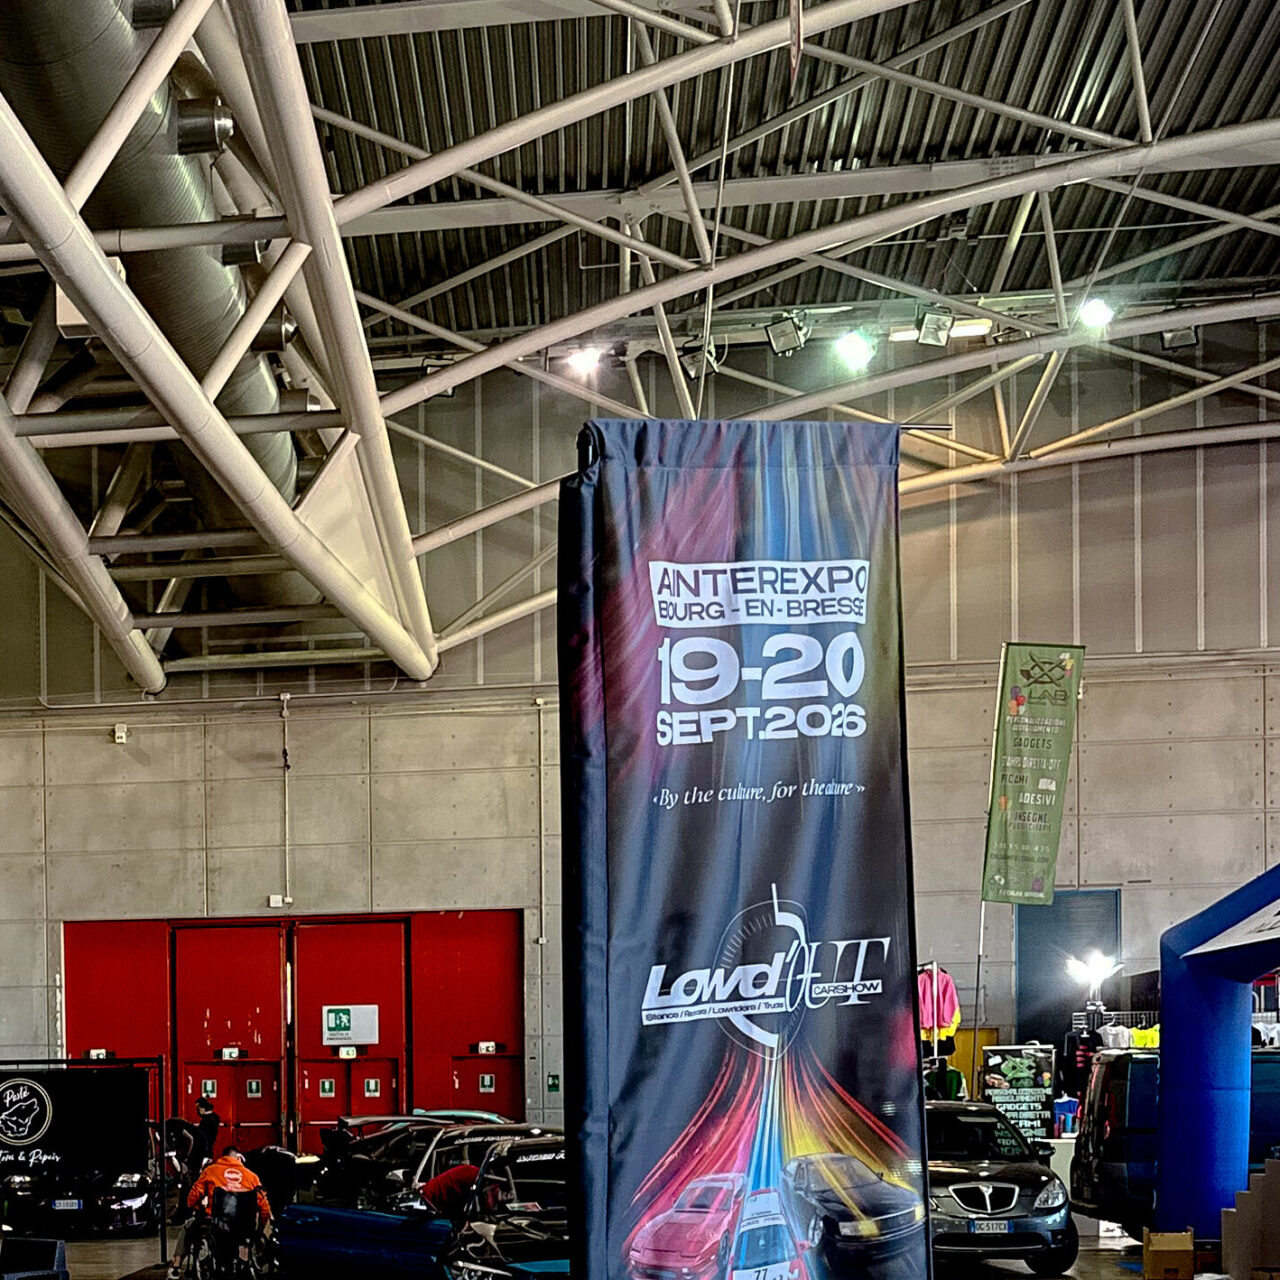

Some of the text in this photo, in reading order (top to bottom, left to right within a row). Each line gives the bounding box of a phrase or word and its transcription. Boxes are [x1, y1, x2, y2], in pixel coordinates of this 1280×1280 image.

[657, 566, 867, 596] AINTEREXPO
[658, 631, 865, 705] 19-20
[684, 786, 712, 805] the
[767, 781, 797, 802] for
[813, 980, 879, 996] CARSHOW
